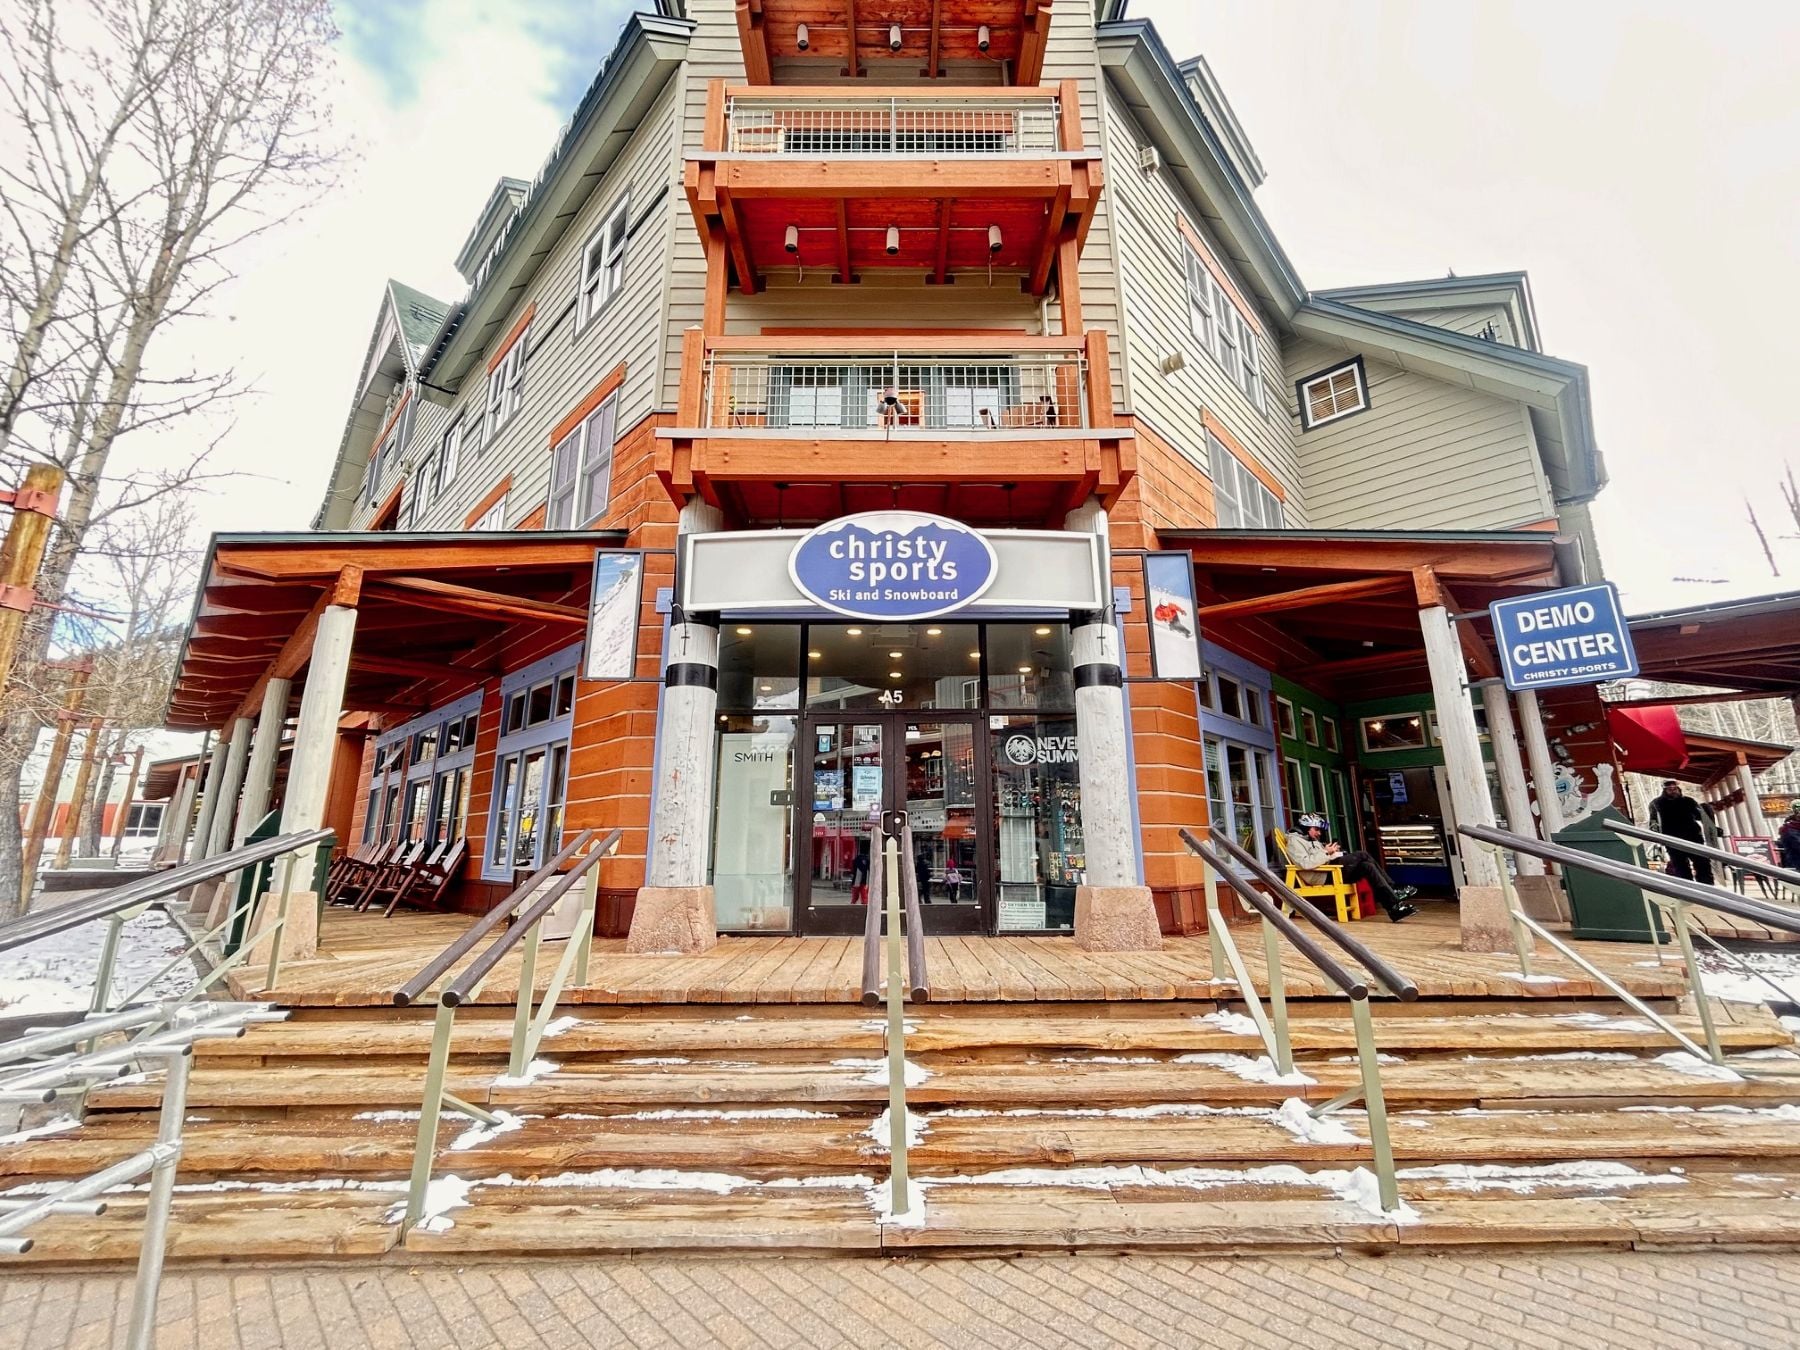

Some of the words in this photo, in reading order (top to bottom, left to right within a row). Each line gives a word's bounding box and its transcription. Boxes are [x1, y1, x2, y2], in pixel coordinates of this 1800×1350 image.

[829, 534, 948, 566] christy
[849, 557, 958, 587] sports
[829, 589, 851, 601] Ski
[855, 588, 880, 601] and
[884, 588, 959, 601] Snowboard
[1516, 601, 1595, 633] DEMO
[1513, 632, 1618, 666] CENTER
[1524, 668, 1568, 680] CHRISTY
[1571, 662, 1616, 674] SPORTS
[880, 689, 903, 704] A5
[734, 752, 774, 762] SMITH
